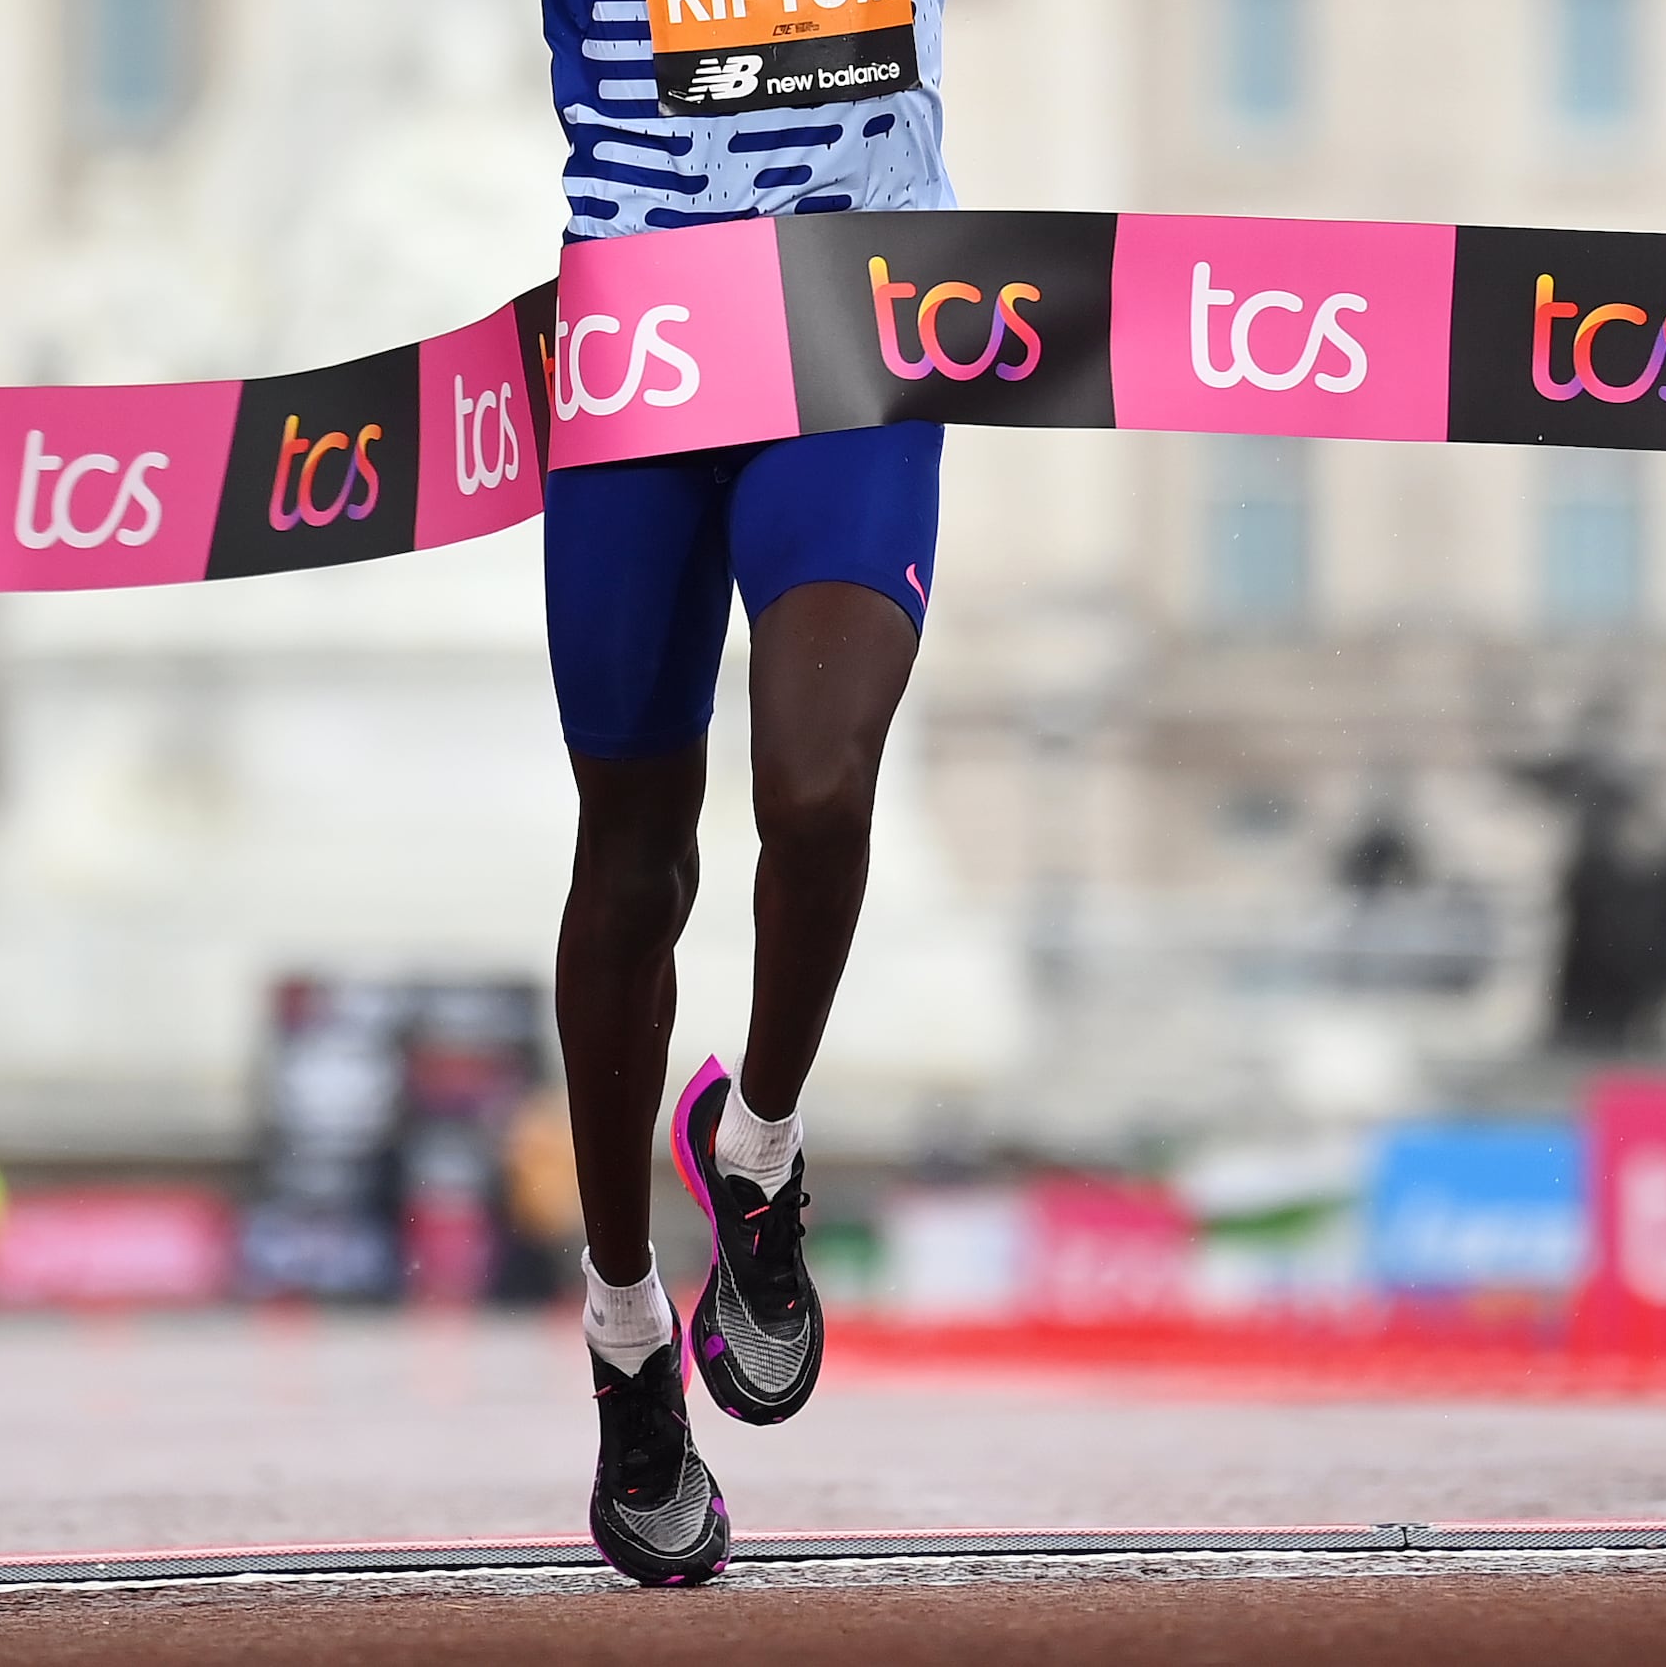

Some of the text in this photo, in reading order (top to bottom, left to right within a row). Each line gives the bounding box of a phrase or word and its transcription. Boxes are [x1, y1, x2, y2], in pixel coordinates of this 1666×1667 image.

[767, 61, 900, 95] new balance
[15, 429, 169, 549] tcs
[268, 414, 382, 532] tcs
[454, 374, 519, 496] tcs
[555, 296, 700, 422] tcs
[867, 255, 1043, 382] tcs
[1190, 261, 1369, 394] tcs
